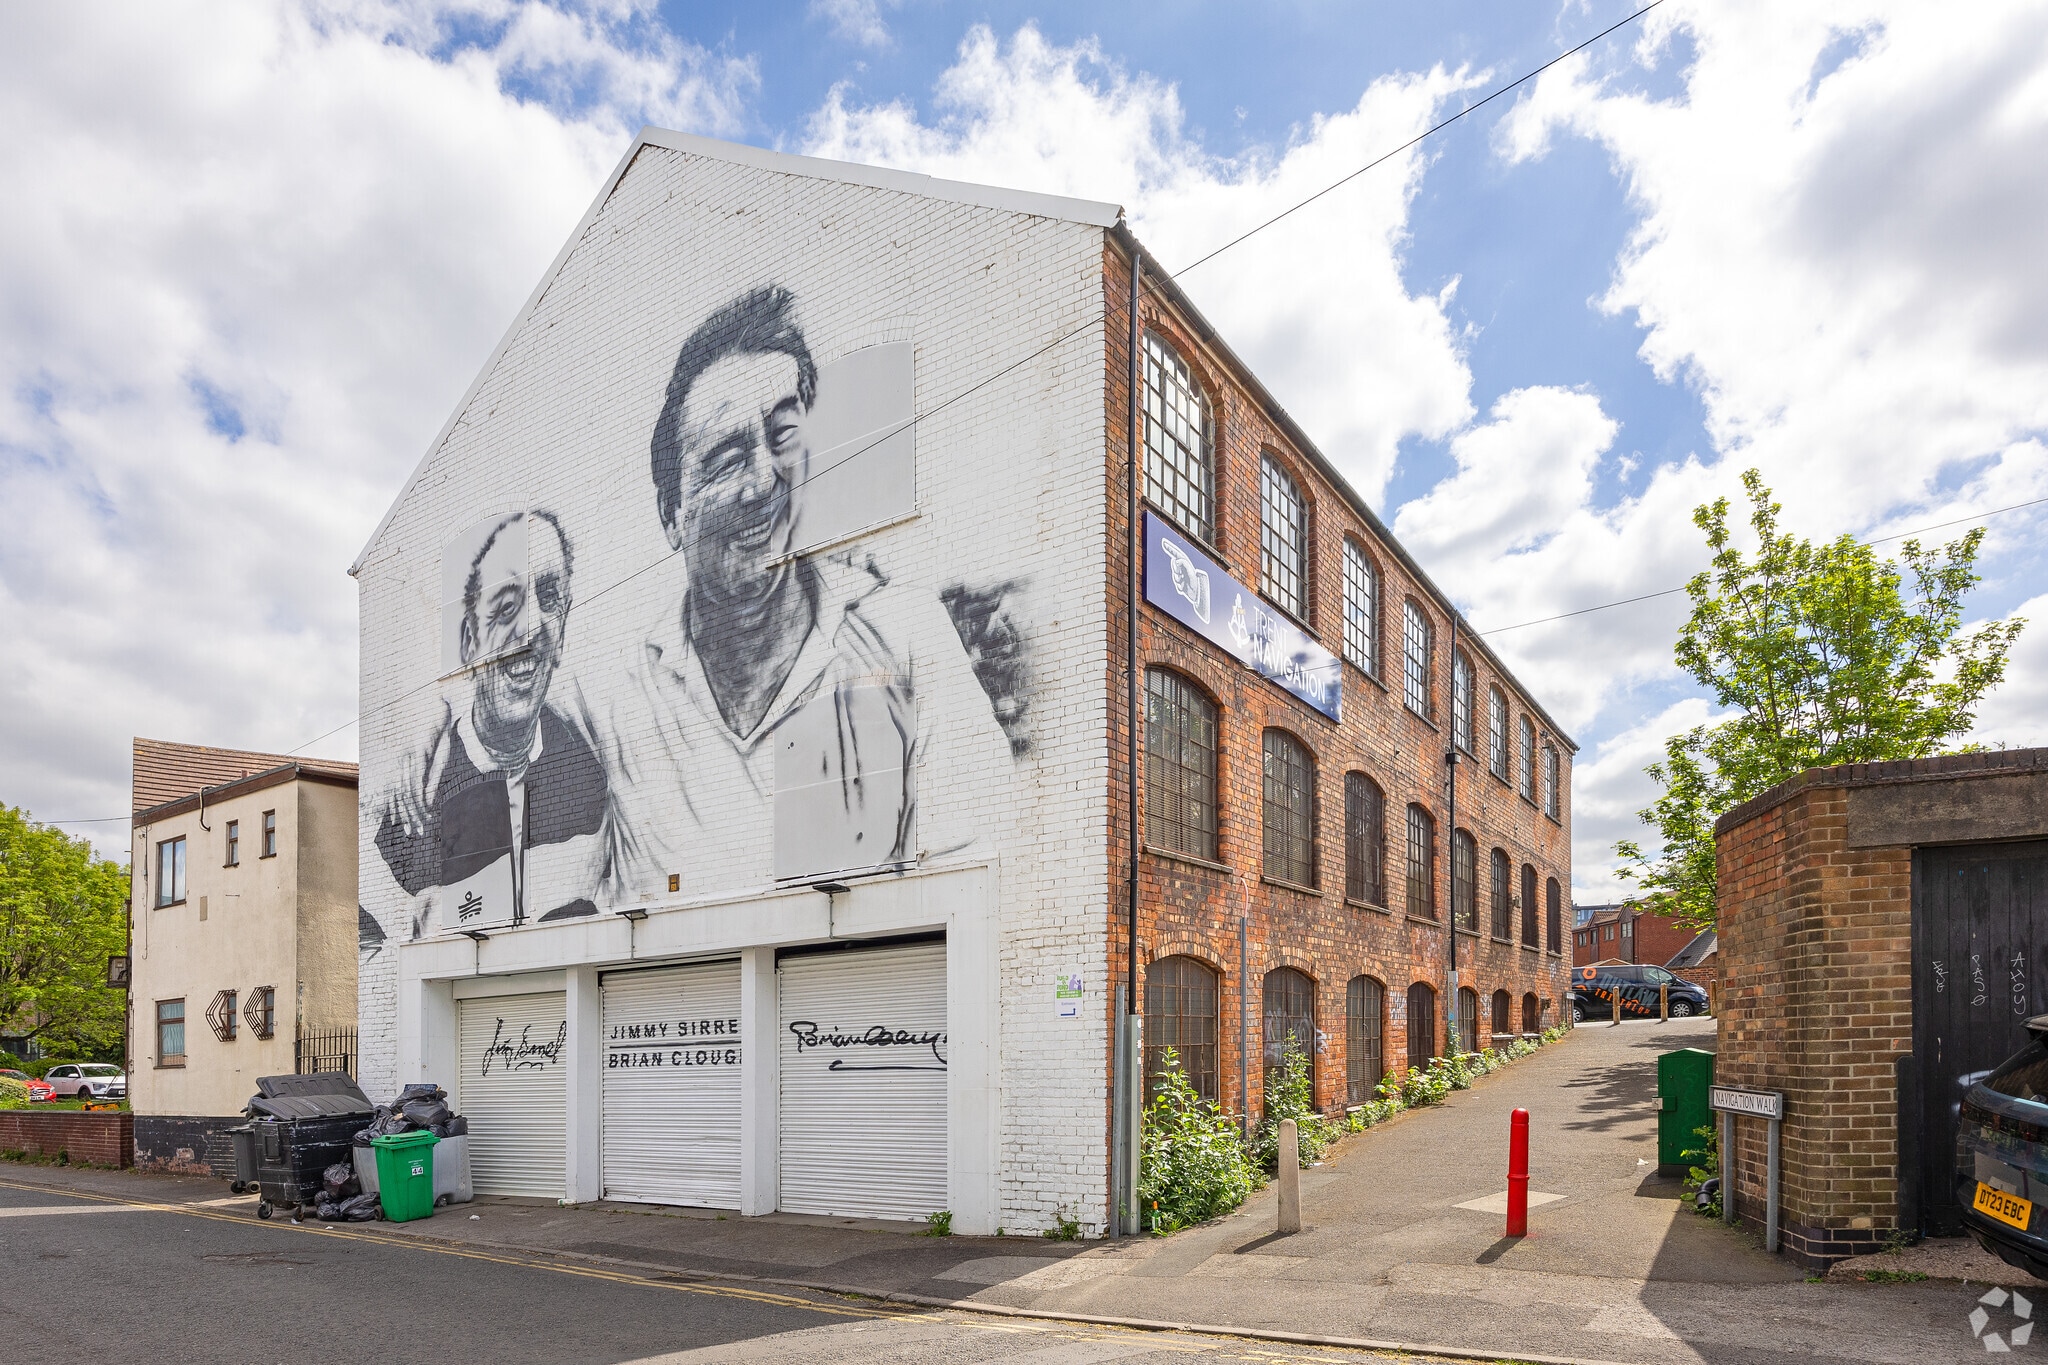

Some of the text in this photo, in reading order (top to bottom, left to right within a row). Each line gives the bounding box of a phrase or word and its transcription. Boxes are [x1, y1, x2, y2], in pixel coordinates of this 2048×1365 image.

[1253, 633, 1326, 705] NAVIGATION
[1594, 988, 1651, 1015] TRITHLON
[610, 1019, 739, 1039] JIMMY SIRRE
[608, 1051, 662, 1069] BRIAN
[1715, 1091, 1777, 1113] NAVIGATION WALK
[1979, 1188, 2025, 1221] DT23 EBC
